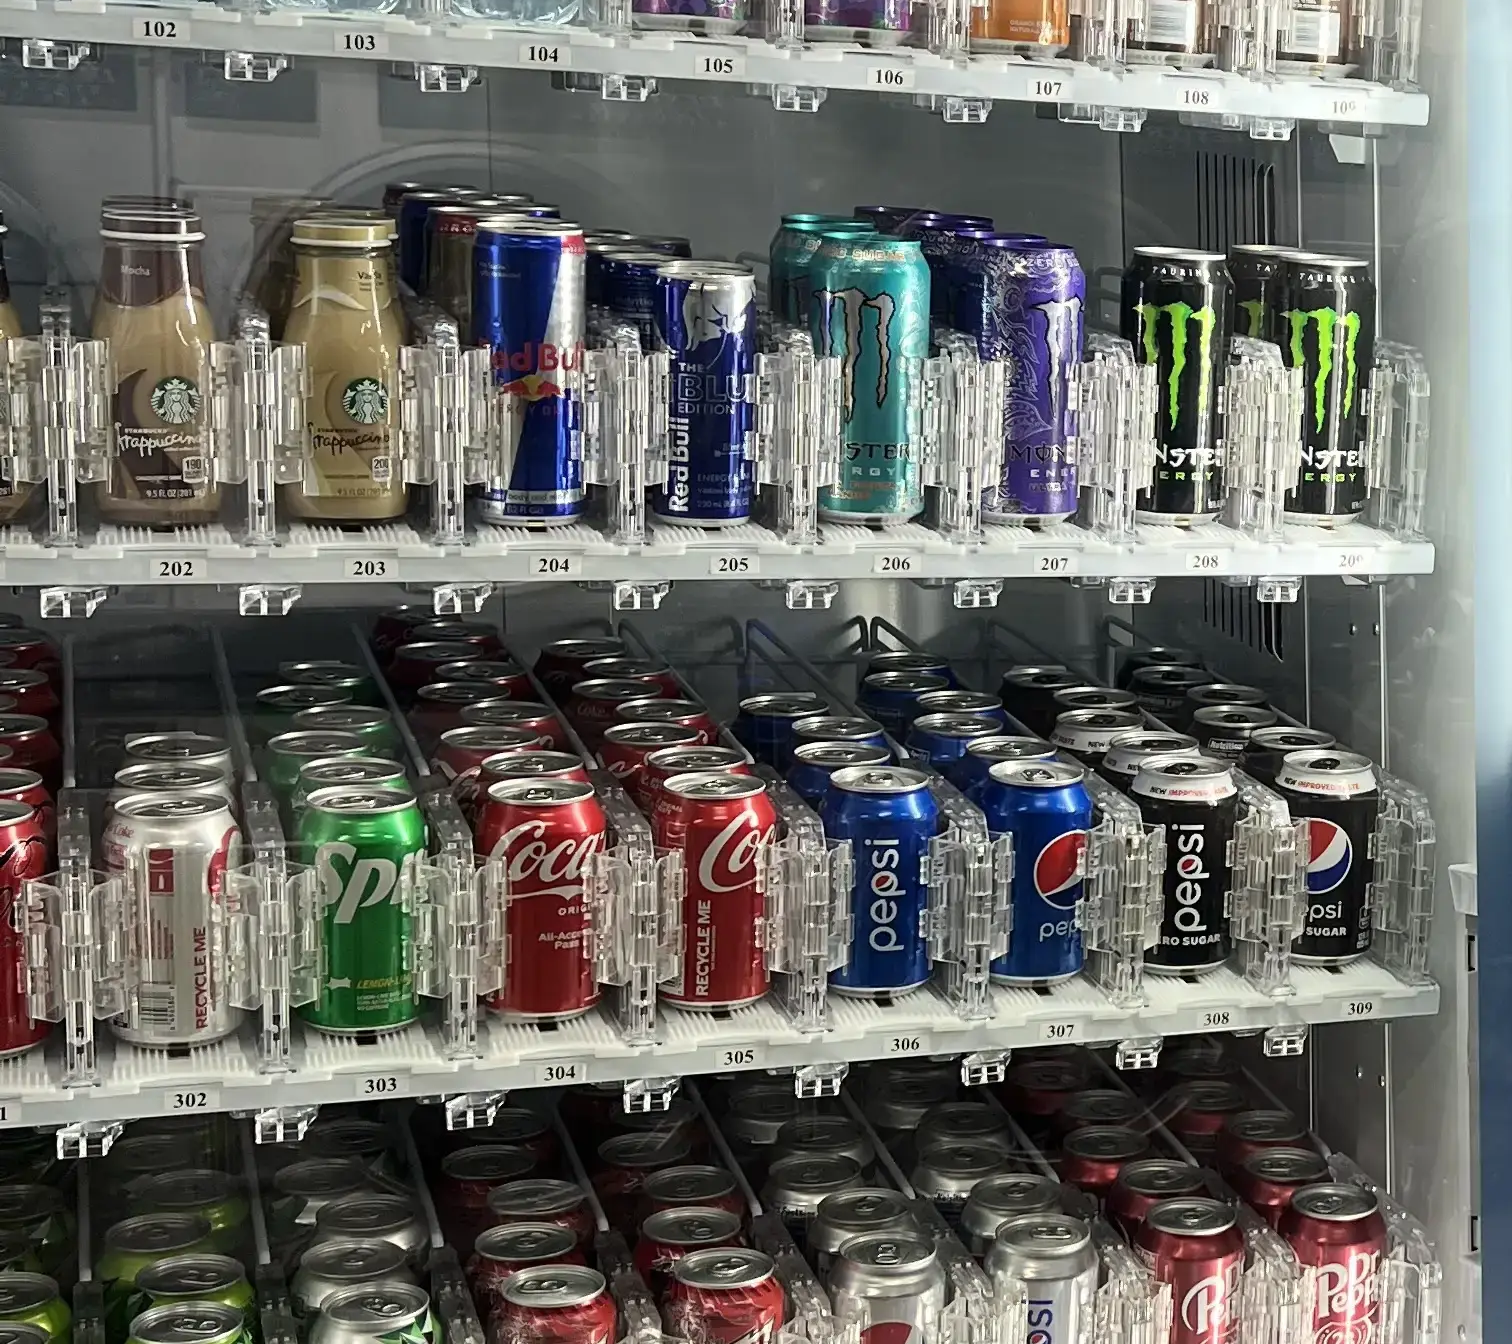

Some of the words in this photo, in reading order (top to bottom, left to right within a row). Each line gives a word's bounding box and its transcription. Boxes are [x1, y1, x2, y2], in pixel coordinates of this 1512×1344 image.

[142, 20, 177, 38] 102
[343, 34, 376, 51] 103
[527, 45, 559, 63] 104
[703, 58, 733, 74] 105
[875, 69, 903, 85] 106
[1035, 81, 1062, 96] 107
[1183, 90, 1209, 105] 108
[120, 264, 151, 276] Mocha
[678, 362, 705, 373] THE
[678, 402, 735, 415] EDITION
[668, 417, 690, 462] Bull
[1159, 471, 1214, 481] ERGY
[1304, 472, 1357, 483] ERGY
[668, 467, 690, 512] Red
[159, 560, 194, 577] 202
[352, 560, 386, 576] 203
[538, 557, 570, 573] 204
[718, 556, 749, 573] 205
[881, 555, 911, 572] 206
[1041, 557, 1069, 572] 207
[1193, 554, 1219, 569] 208
[1172, 823, 1209, 932] pepsi
[864, 838, 906, 953] pepsi
[696, 899, 711, 924] ME
[193, 926, 207, 953] ME
[1182, 933, 1221, 946] SUGAR
[1306, 926, 1347, 937] SUGAR
[695, 925, 711, 997] RECYCLE
[194, 954, 208, 1030] RECYCLE
[1347, 1001, 1373, 1016] 309
[1203, 1011, 1230, 1026] 308
[1046, 1023, 1074, 1040] 307
[890, 1036, 921, 1052] 306
[723, 1049, 754, 1066] 305
[544, 1066, 576, 1082] 304
[364, 1077, 397, 1094] 303
[173, 1092, 207, 1109] 302
